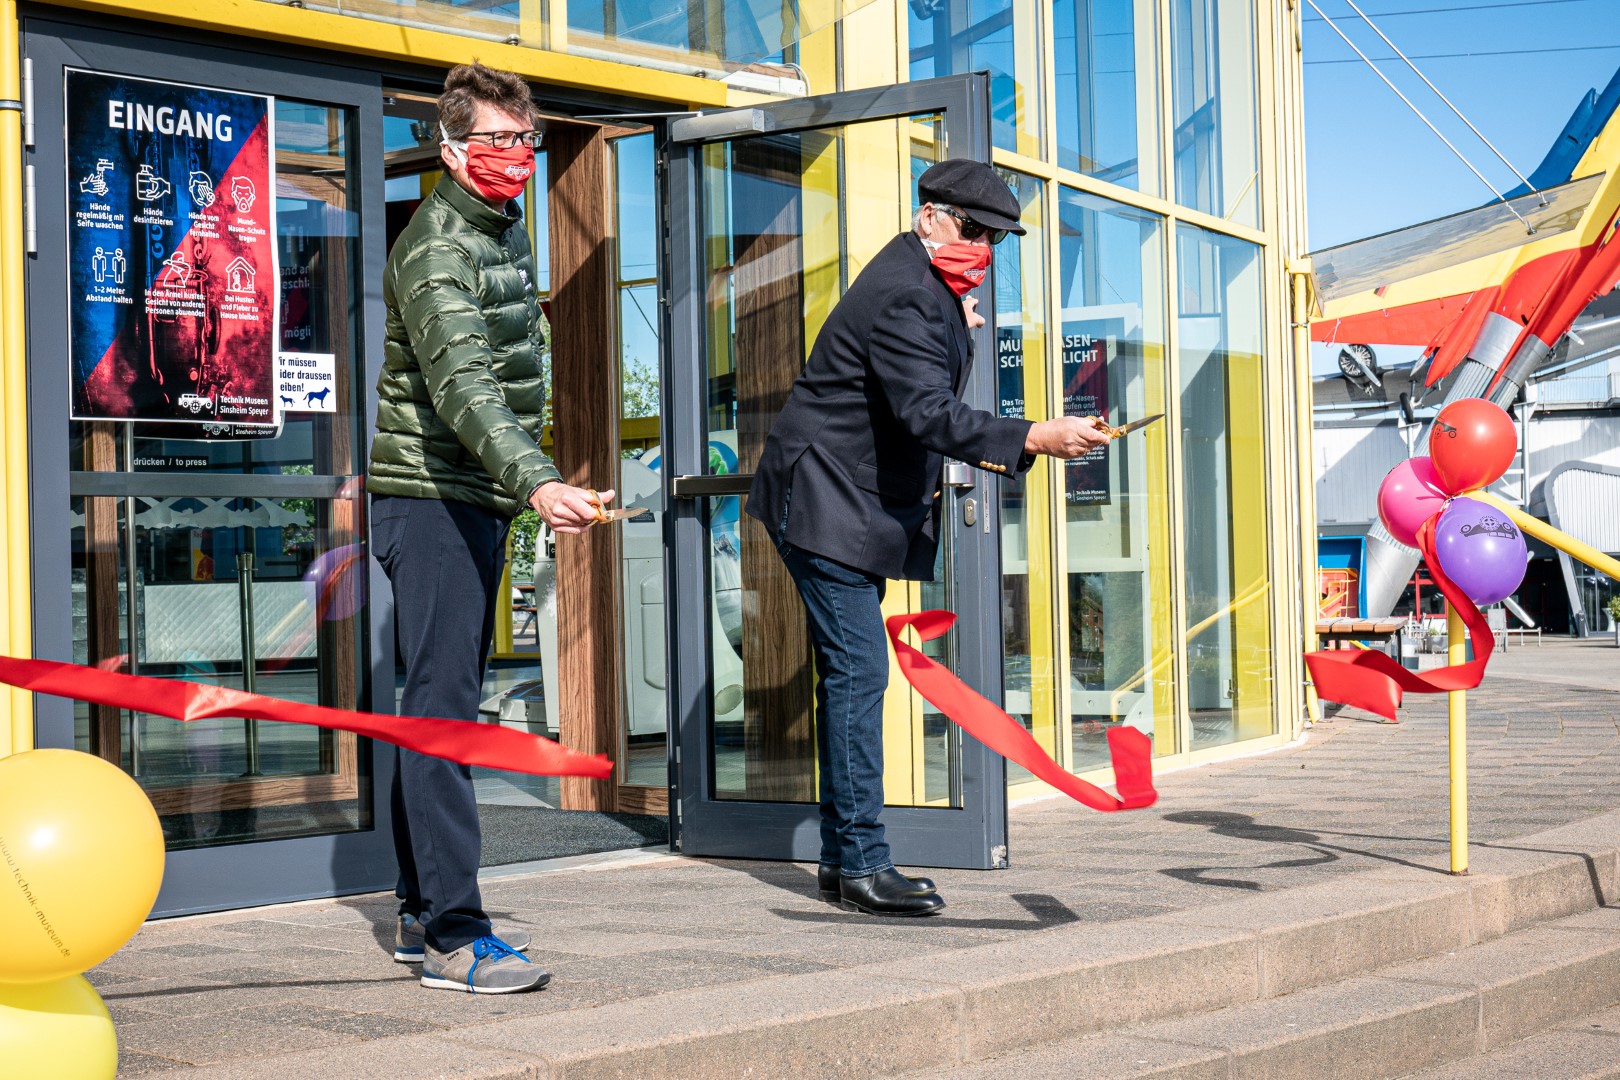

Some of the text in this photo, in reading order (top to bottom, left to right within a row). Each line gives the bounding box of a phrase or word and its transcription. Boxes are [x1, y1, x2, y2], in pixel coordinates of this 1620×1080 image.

[108, 100, 233, 142] EINGANG
[89, 203, 111, 211] Hände
[143, 208, 163, 216] Hände
[76, 212, 112, 221] regelmäßig
[134, 216, 174, 226] desinfizieren
[188, 212, 206, 220] Hände
[77, 220, 124, 230] Seife waschen
[238, 234, 256, 243] tragen
[106, 287, 125, 295] Meter
[152, 289, 164, 297] den
[165, 289, 183, 298] Ärmel
[86, 294, 133, 304] Abstand halten
[145, 297, 168, 305] Gesicht
[182, 300, 206, 308] anderen
[235, 296, 254, 304] Husten
[145, 307, 206, 317] Personen abwenden
[278, 356, 317, 367] ir müssen
[280, 369, 332, 380] ider draussen
[280, 382, 304, 392] eiben!
[220, 396, 268, 405] Technik Museen
[220, 406, 268, 416] Sinsheim Speyer
[133, 458, 165, 466] drücken
[175, 458, 184, 466] to
[185, 459, 207, 468] press
